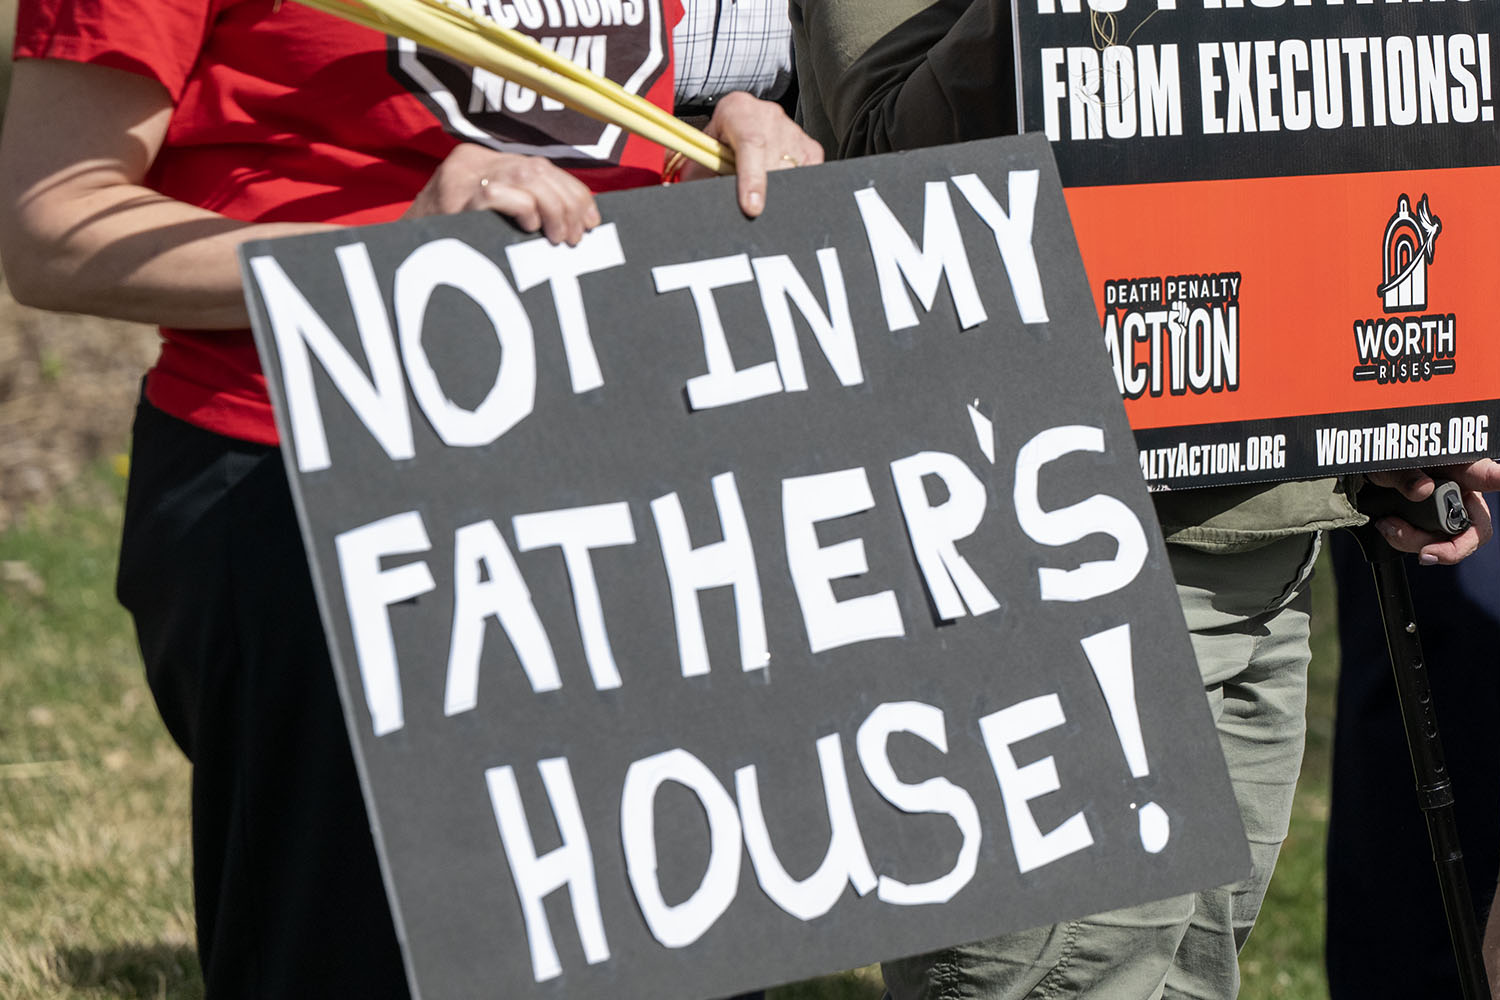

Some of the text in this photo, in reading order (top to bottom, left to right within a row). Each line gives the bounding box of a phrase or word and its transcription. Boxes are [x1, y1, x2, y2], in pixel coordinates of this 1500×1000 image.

[1041, 33, 1495, 142] FROM EXECUTIONS!
[251, 168, 1050, 472] NOT IN MY
[1107, 277, 1239, 304] DEATH PENALTY
[1356, 320, 1454, 359] WORTH
[1379, 361, 1431, 379] RISES
[336, 397, 1150, 737] FATHER'S
[485, 623, 1170, 982] HOUSE!
